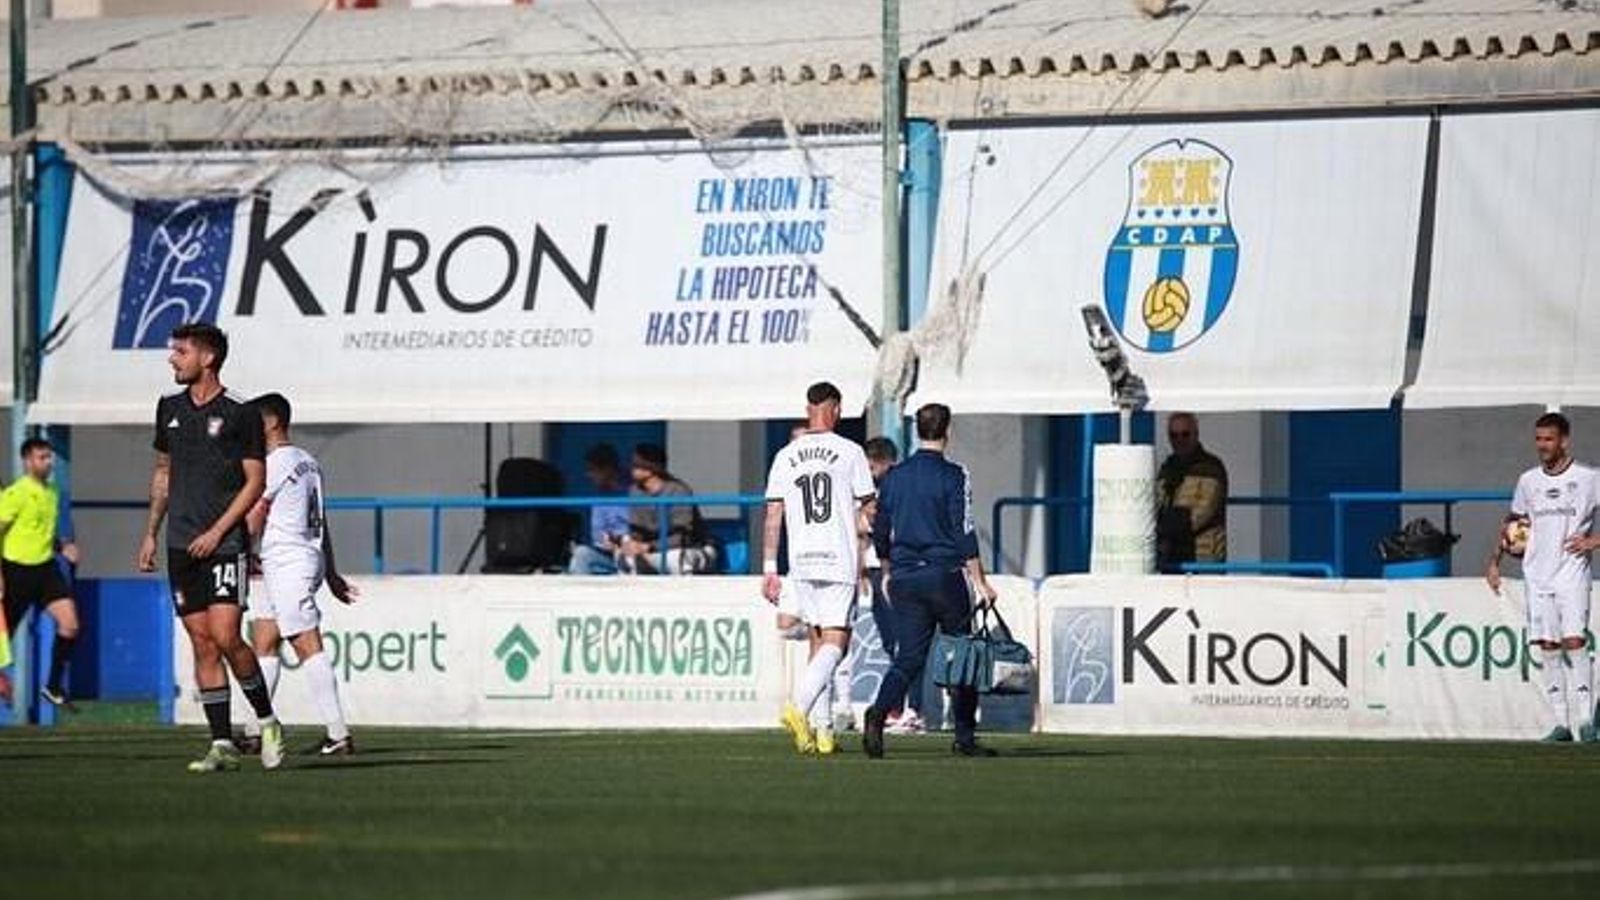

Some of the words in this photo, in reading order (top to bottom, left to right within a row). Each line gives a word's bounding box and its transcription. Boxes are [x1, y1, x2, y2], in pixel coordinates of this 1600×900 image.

[696, 178, 726, 213] EN
[809, 175, 833, 210] TE
[701, 220, 827, 257] BUSCAMOS
[676, 267, 704, 301] LA
[711, 264, 818, 300] HIPOTECA
[343, 330, 488, 350] INTERMEDIARIOS
[492, 330, 516, 348] DE
[645, 311, 720, 345] HASTA
[727, 310, 750, 343] EL
[795, 471, 832, 525] 19
[212, 564, 238, 588] 14
[557, 616, 752, 676] TECNOCASA
[1406, 611, 1595, 682] Kopp
